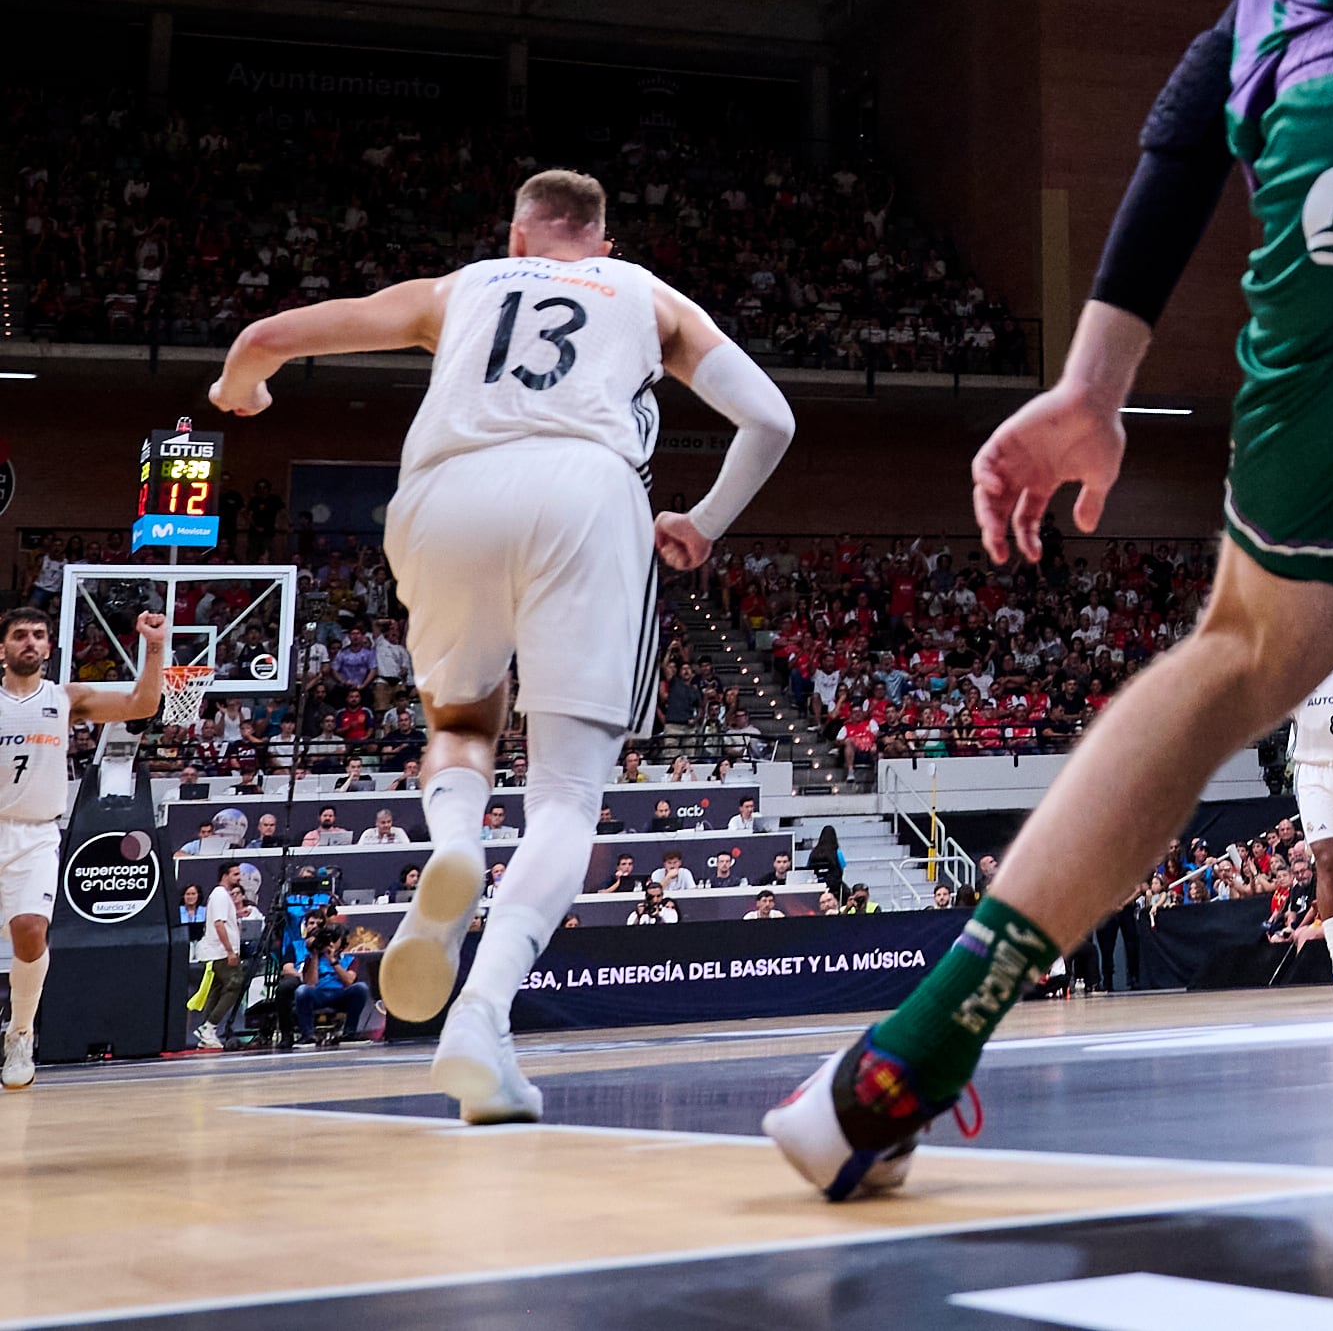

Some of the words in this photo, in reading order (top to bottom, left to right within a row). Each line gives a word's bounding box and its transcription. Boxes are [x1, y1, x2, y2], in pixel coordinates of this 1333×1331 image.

[226, 61, 442, 101] Ayuntamiento
[484, 271, 617, 298] AUTOHERO
[484, 290, 588, 391] 13
[160, 444, 214, 458] LOTUS
[170, 459, 211, 480] 2:39
[169, 482, 209, 516] 12
[176, 527, 212, 537] Movistar
[13, 754, 30, 784] 7
[676, 804, 704, 817] acb
[75, 864, 149, 882] supercopa
[80, 876, 148, 892] endesa
[96, 903, 124, 912] Murcia
[566, 969, 594, 989] LA
[597, 960, 685, 986] ENERGÍA
[689, 961, 726, 981] DEL
[729, 956, 805, 978] BASKET
[807, 955, 822, 974] Y
[824, 953, 850, 973] LA
[852, 947, 926, 971] MÚSICA
